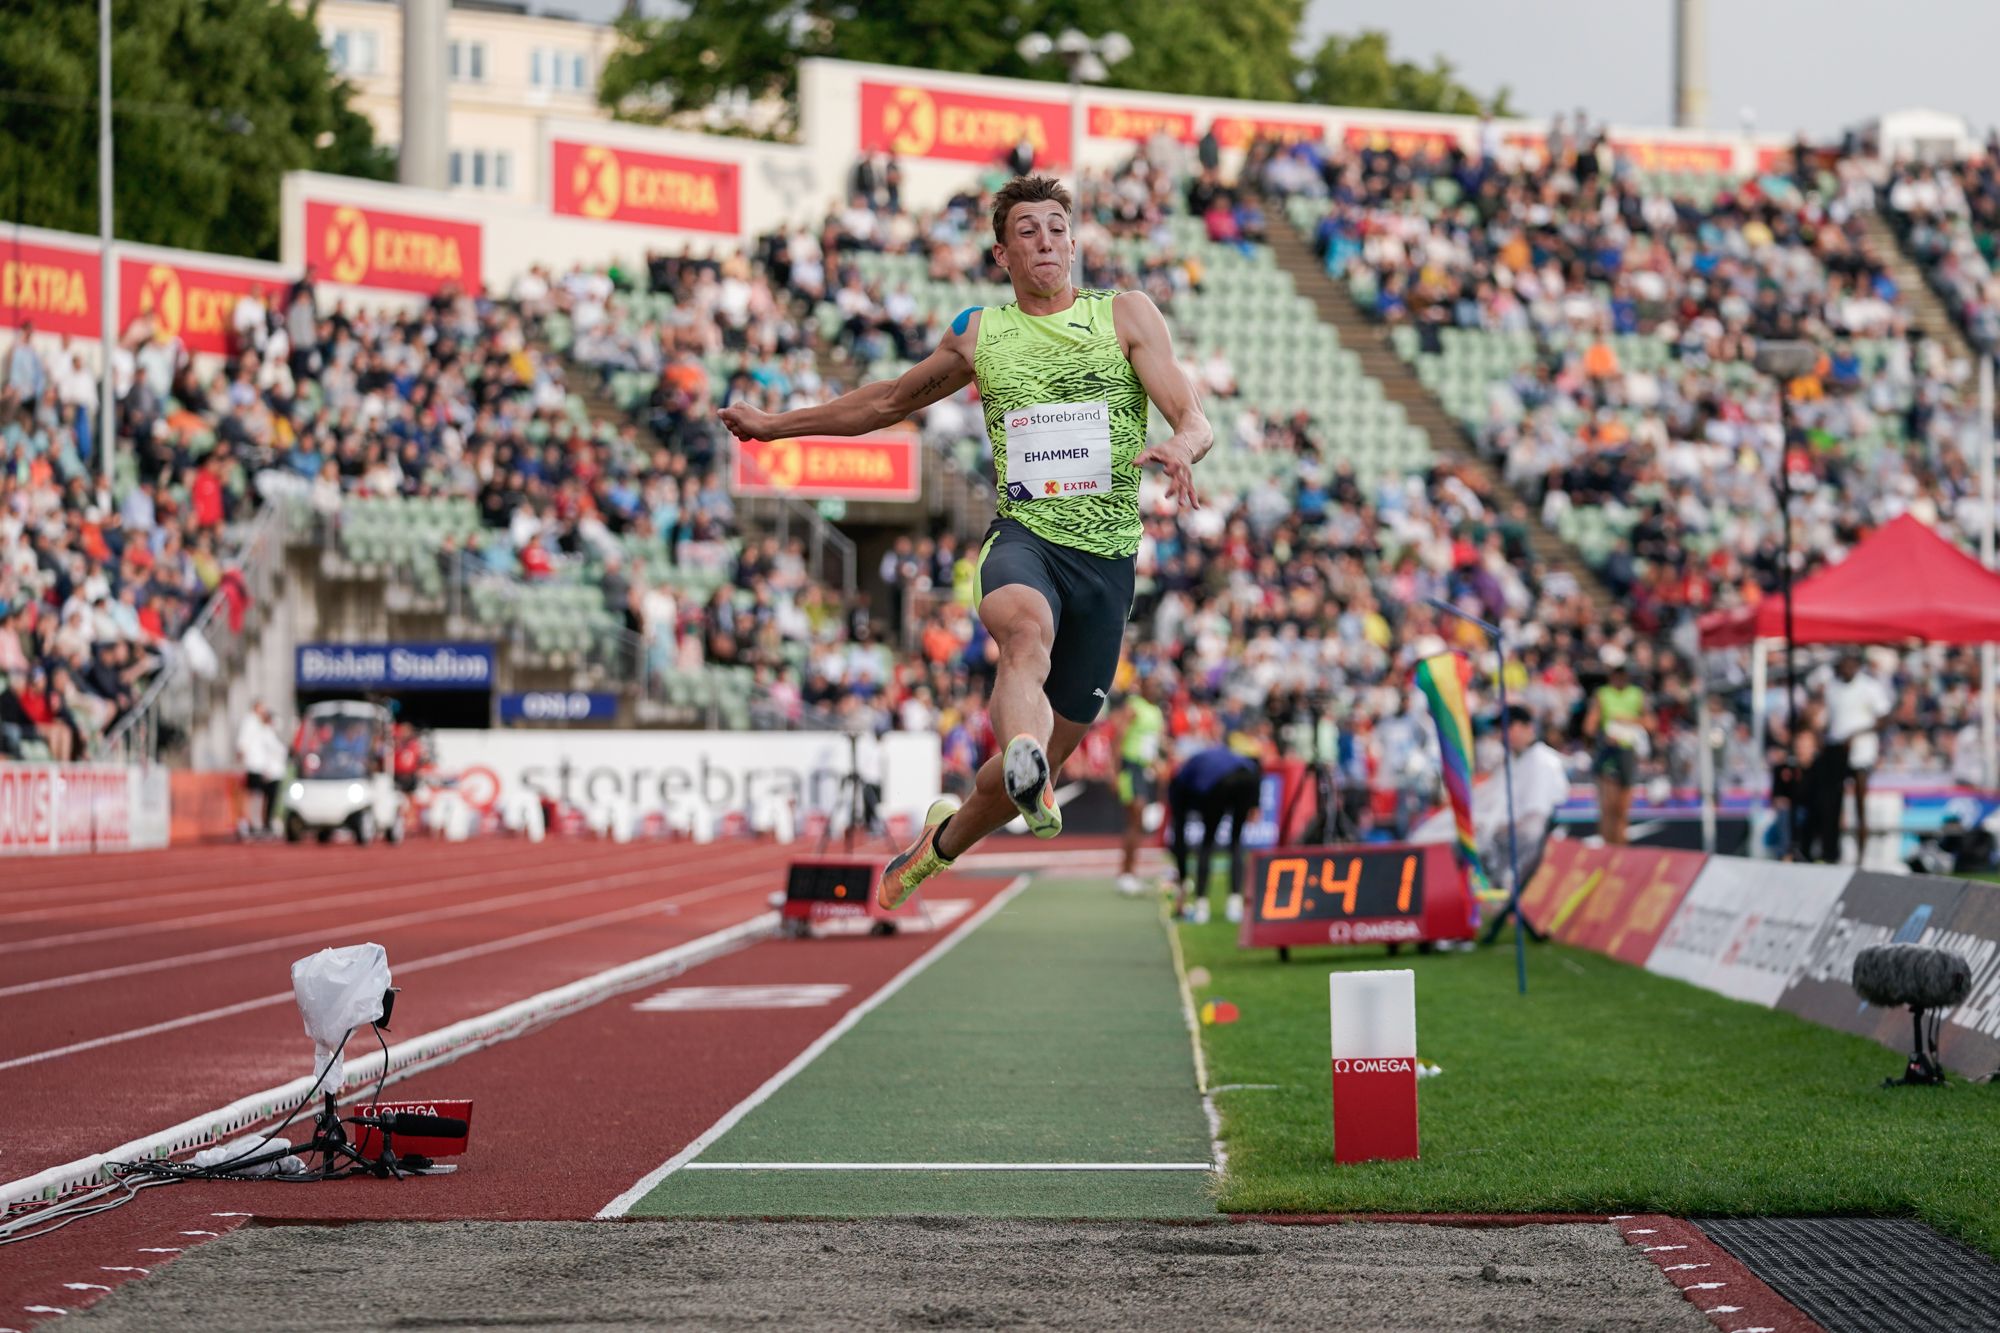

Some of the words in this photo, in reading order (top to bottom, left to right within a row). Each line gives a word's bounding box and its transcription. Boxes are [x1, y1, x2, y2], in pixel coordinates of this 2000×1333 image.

[624, 165, 720, 216] EXTRA
[374, 226, 463, 279] EXTRA
[3, 260, 88, 316] EXTRA
[1030, 409, 1101, 425] storebrand
[1024, 447, 1089, 463] EHAMMER
[1063, 480, 1098, 491] EXTRA
[519, 756, 844, 807] storebran
[1352, 922, 1421, 942] OMEGA
[1353, 1059, 1411, 1073] OMEGA
